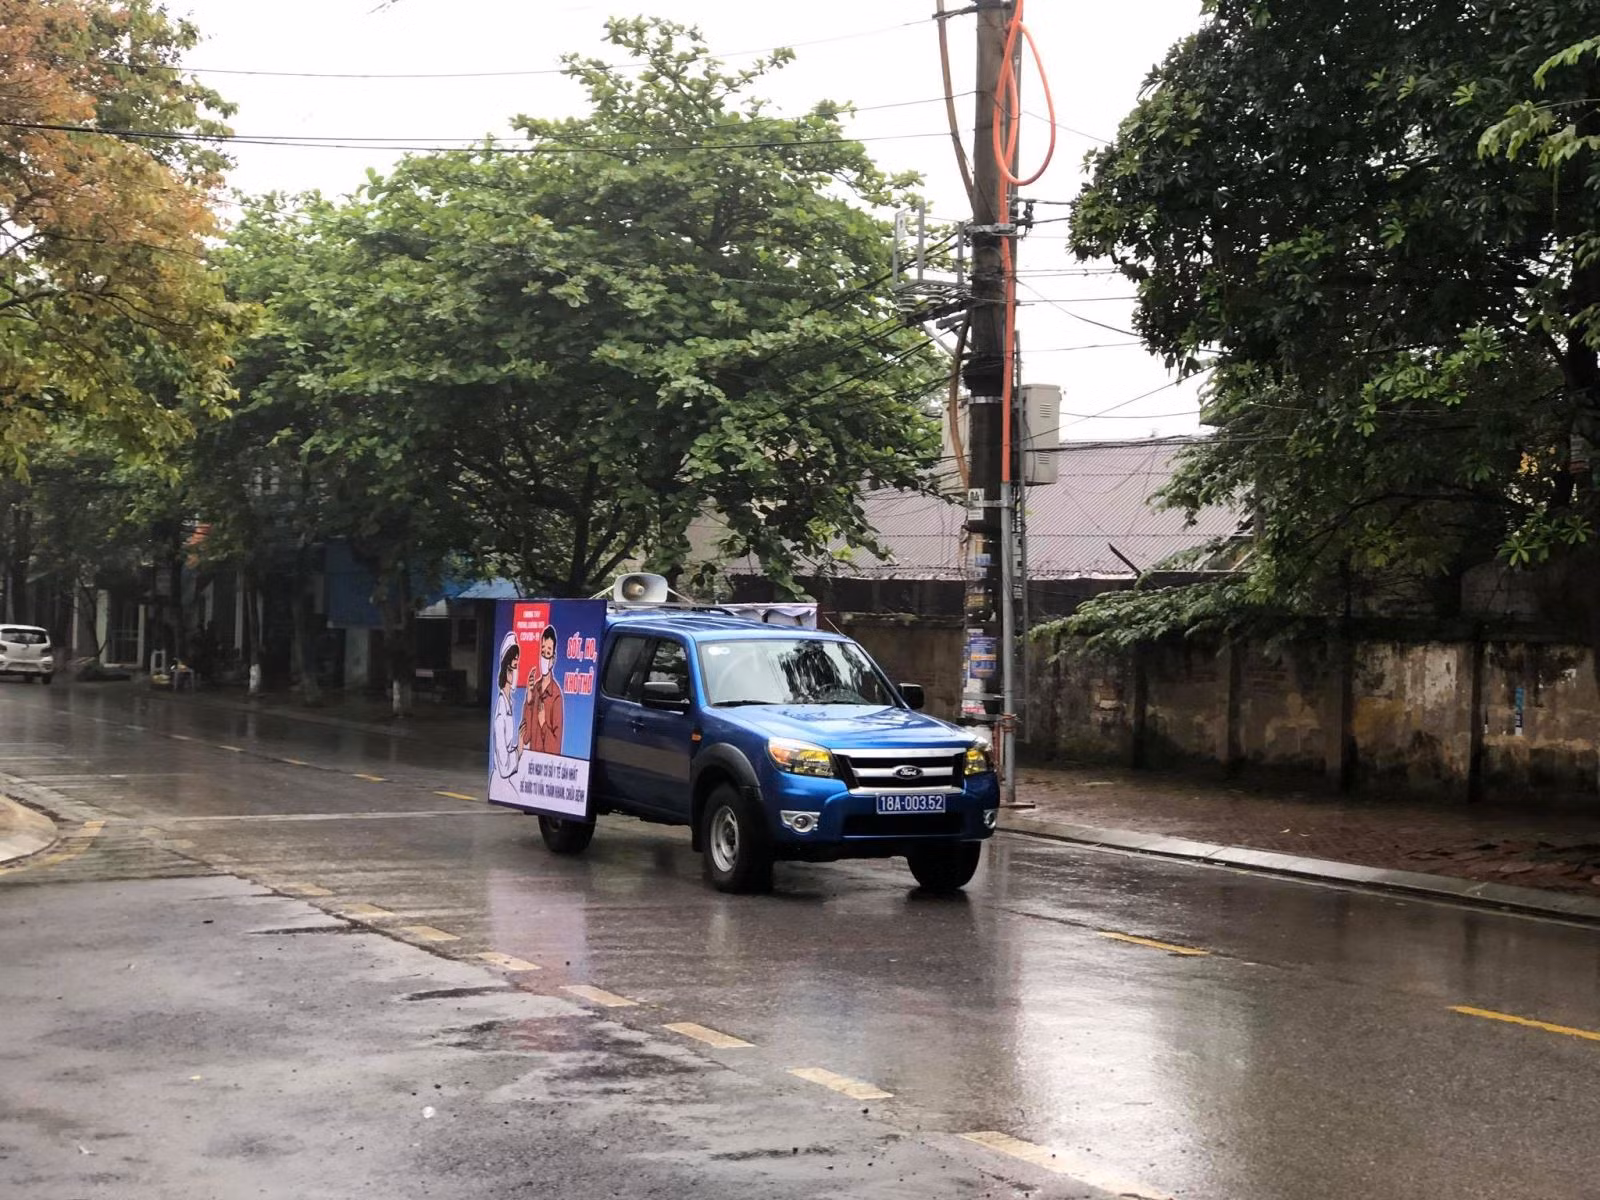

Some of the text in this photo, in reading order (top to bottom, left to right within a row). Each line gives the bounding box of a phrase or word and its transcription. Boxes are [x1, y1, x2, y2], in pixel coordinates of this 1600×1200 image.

[567, 631, 583, 662] SỐT,
[564, 666, 594, 695] KHÓ THỞ
[900, 768, 917, 776] Ford
